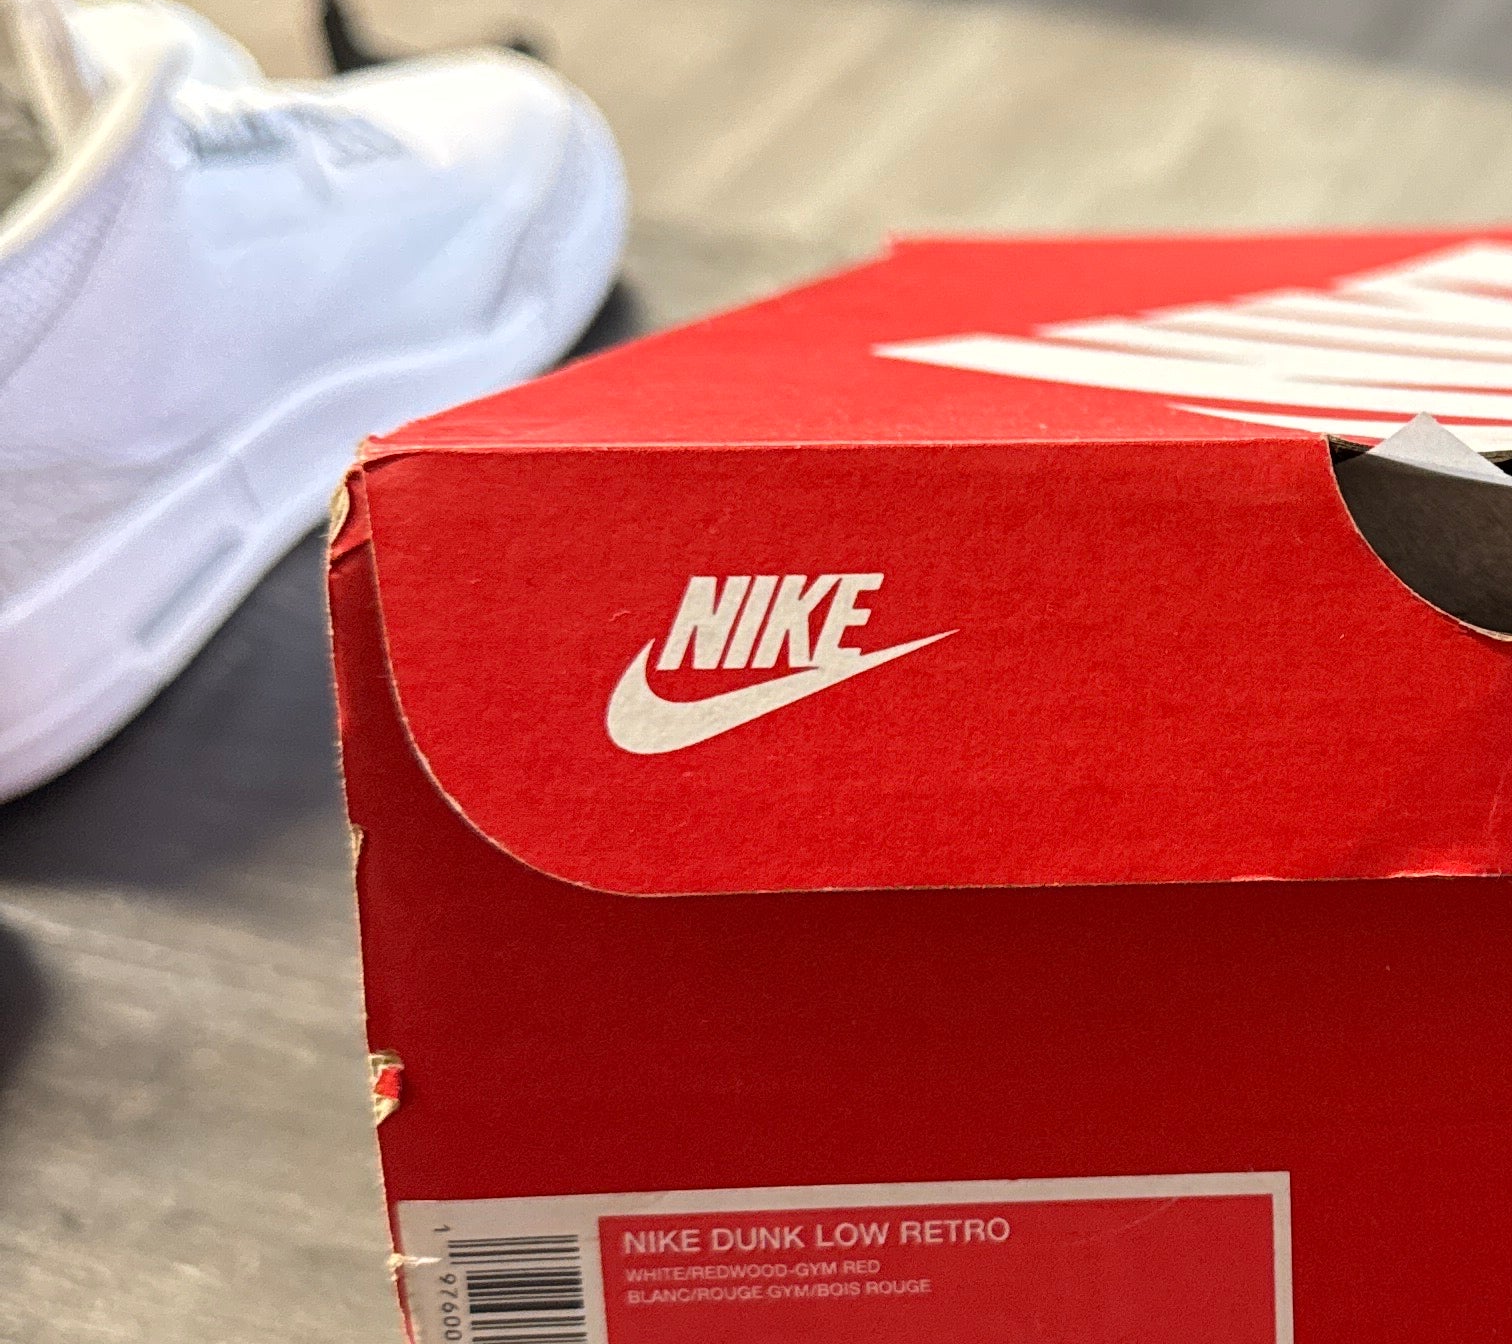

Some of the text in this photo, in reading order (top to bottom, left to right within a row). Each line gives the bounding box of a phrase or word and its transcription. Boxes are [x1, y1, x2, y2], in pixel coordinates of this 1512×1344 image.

[655, 573, 885, 670] NIKE
[623, 1217, 1010, 1254] NIKE DUNK LOW RETRO
[625, 1260, 881, 1283] WHITE/REDWOOD-GYM RED
[866, 1279, 932, 1295] ROUGE
[439, 1272, 463, 1342] 97600
